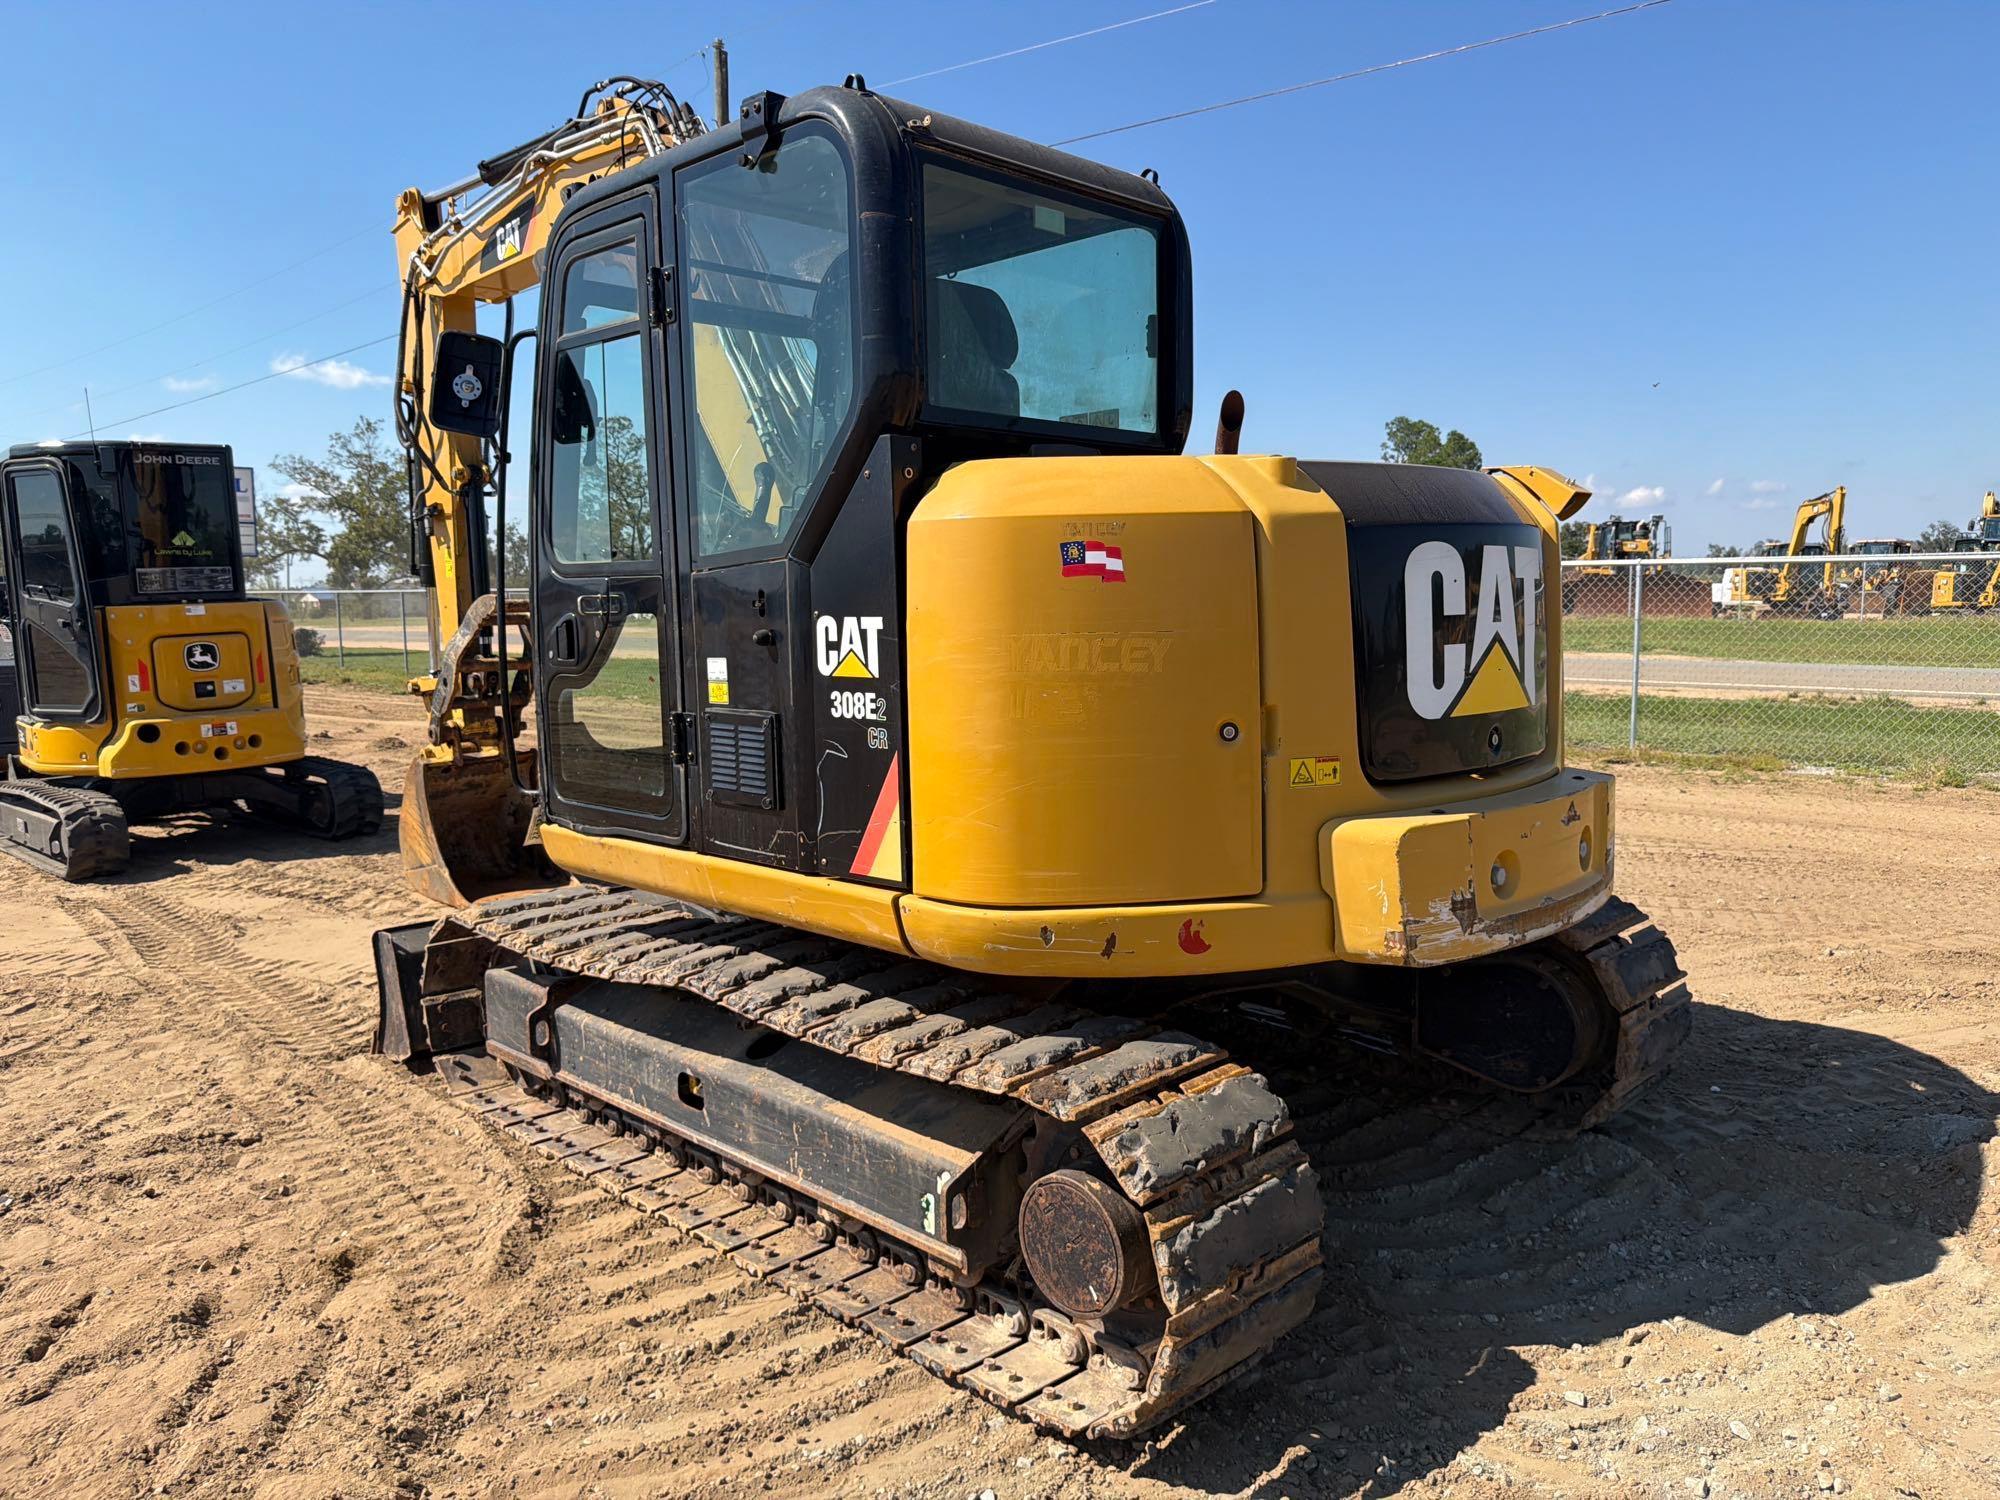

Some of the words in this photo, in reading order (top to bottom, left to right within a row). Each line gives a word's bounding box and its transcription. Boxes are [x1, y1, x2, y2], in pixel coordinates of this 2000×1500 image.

[496, 217, 521, 261] CAT
[133, 453, 173, 465] JOHN
[175, 454, 220, 465] DEERE
[816, 615, 884, 679] CAT
[1404, 540, 1540, 720] CAT
[867, 726, 889, 749] CR
